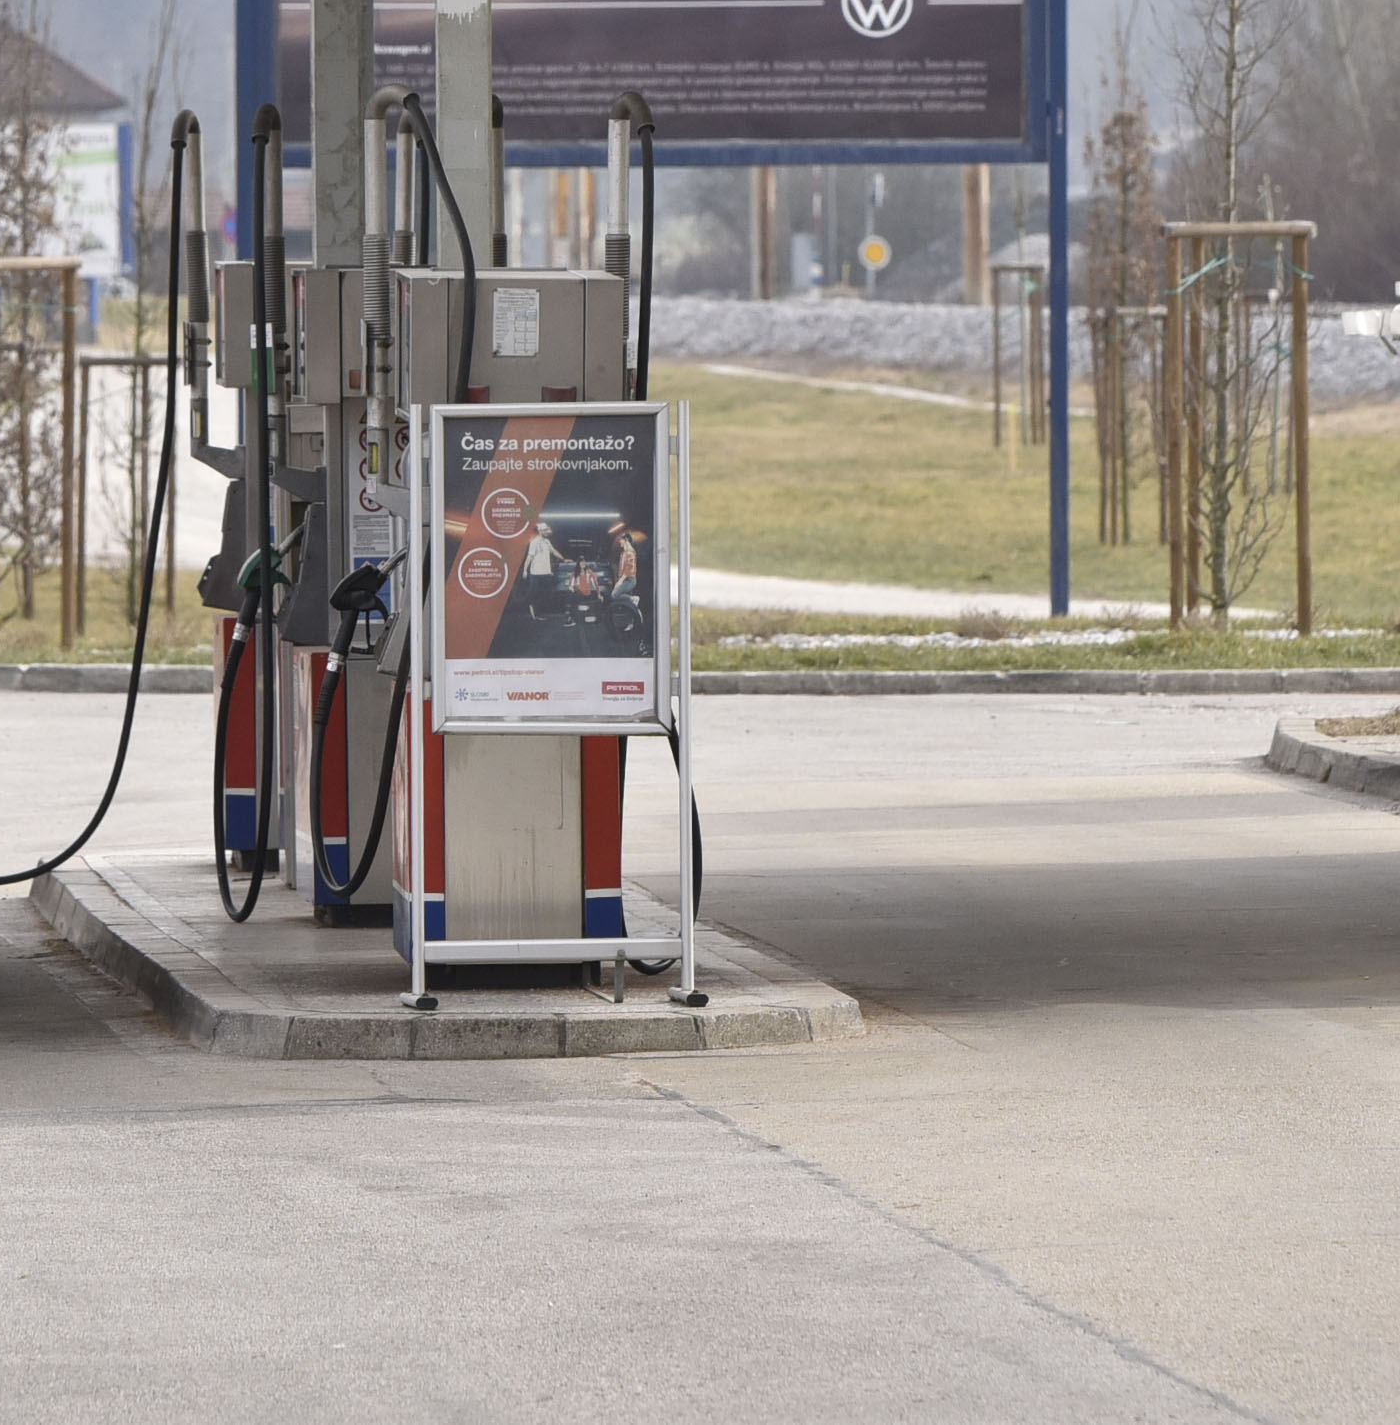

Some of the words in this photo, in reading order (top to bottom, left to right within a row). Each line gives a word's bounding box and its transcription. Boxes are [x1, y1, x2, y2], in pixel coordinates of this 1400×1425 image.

[461, 432, 495, 451] Čas
[499, 439, 518, 451] za
[523, 435, 636, 454] premontažo?
[462, 457, 523, 474] Zaupajte
[527, 456, 634, 473] strokovnjakom.
[506, 691, 550, 701] VIANOR
